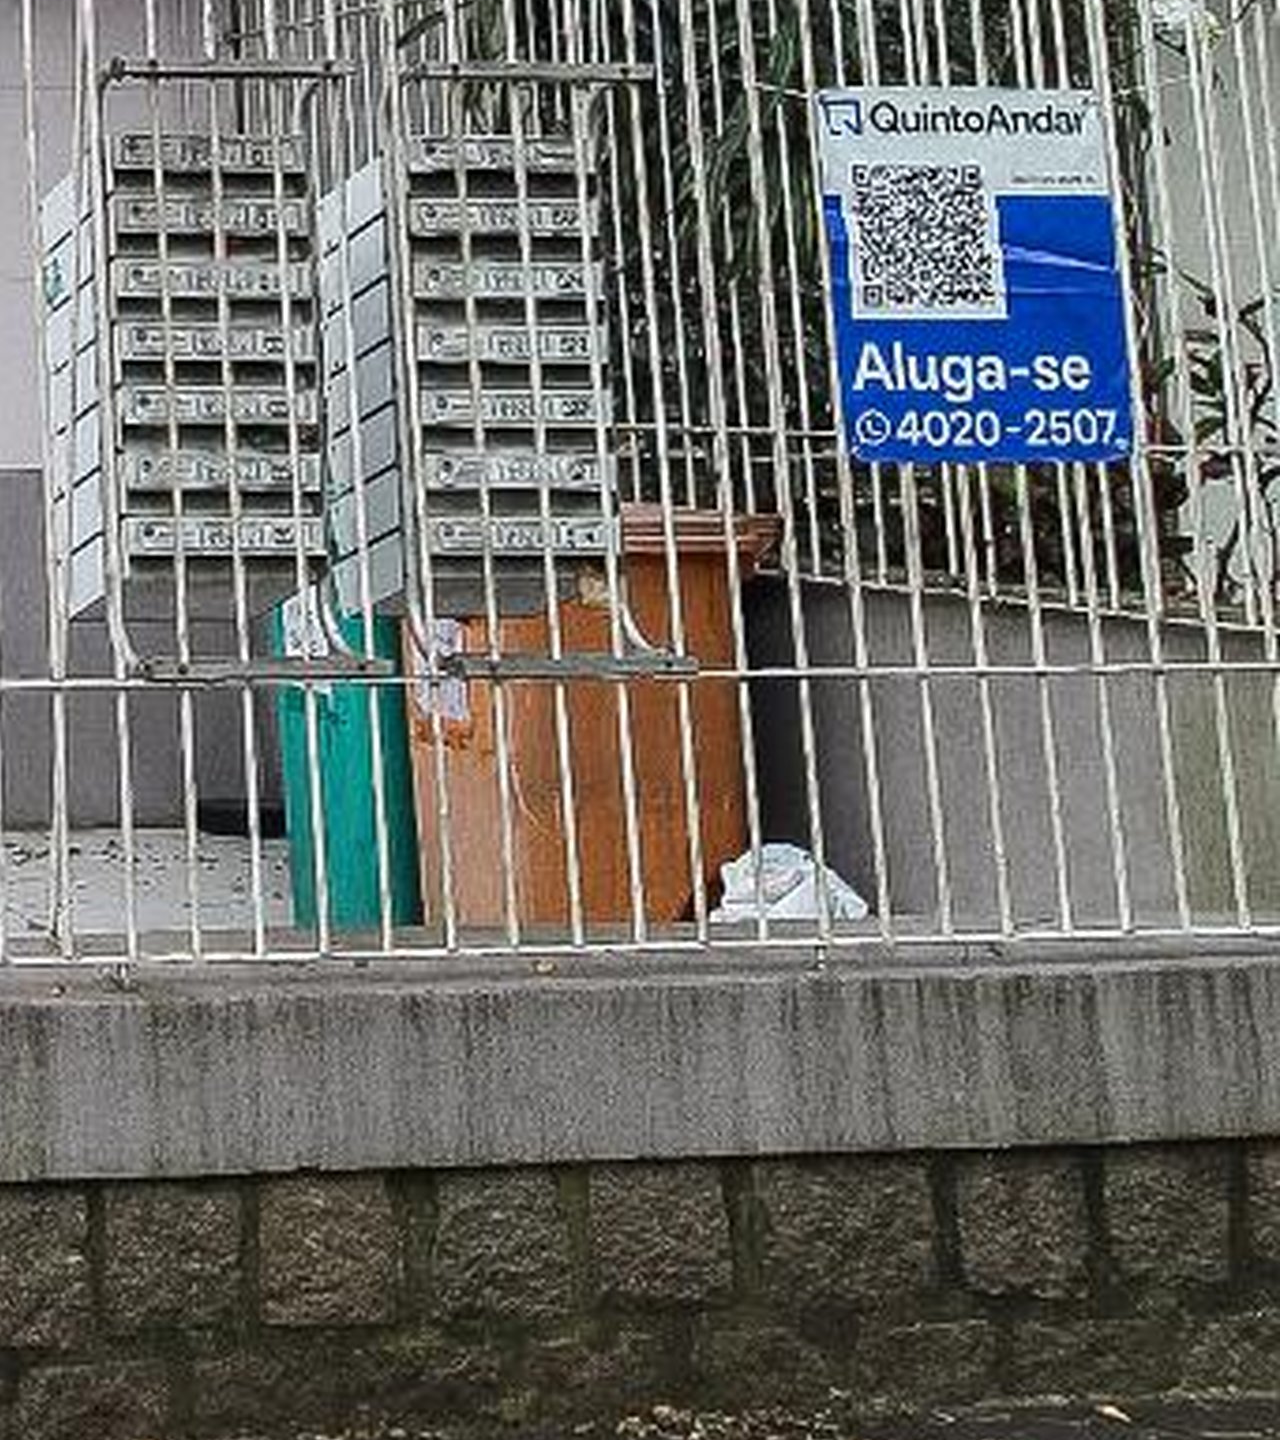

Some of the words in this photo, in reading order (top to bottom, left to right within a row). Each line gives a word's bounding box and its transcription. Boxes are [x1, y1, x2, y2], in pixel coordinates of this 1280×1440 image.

[869, 101, 1086, 135] QuintoAndar
[852, 341, 1092, 402] Aluga-se
[896, 409, 1117, 448] 4020-2507
